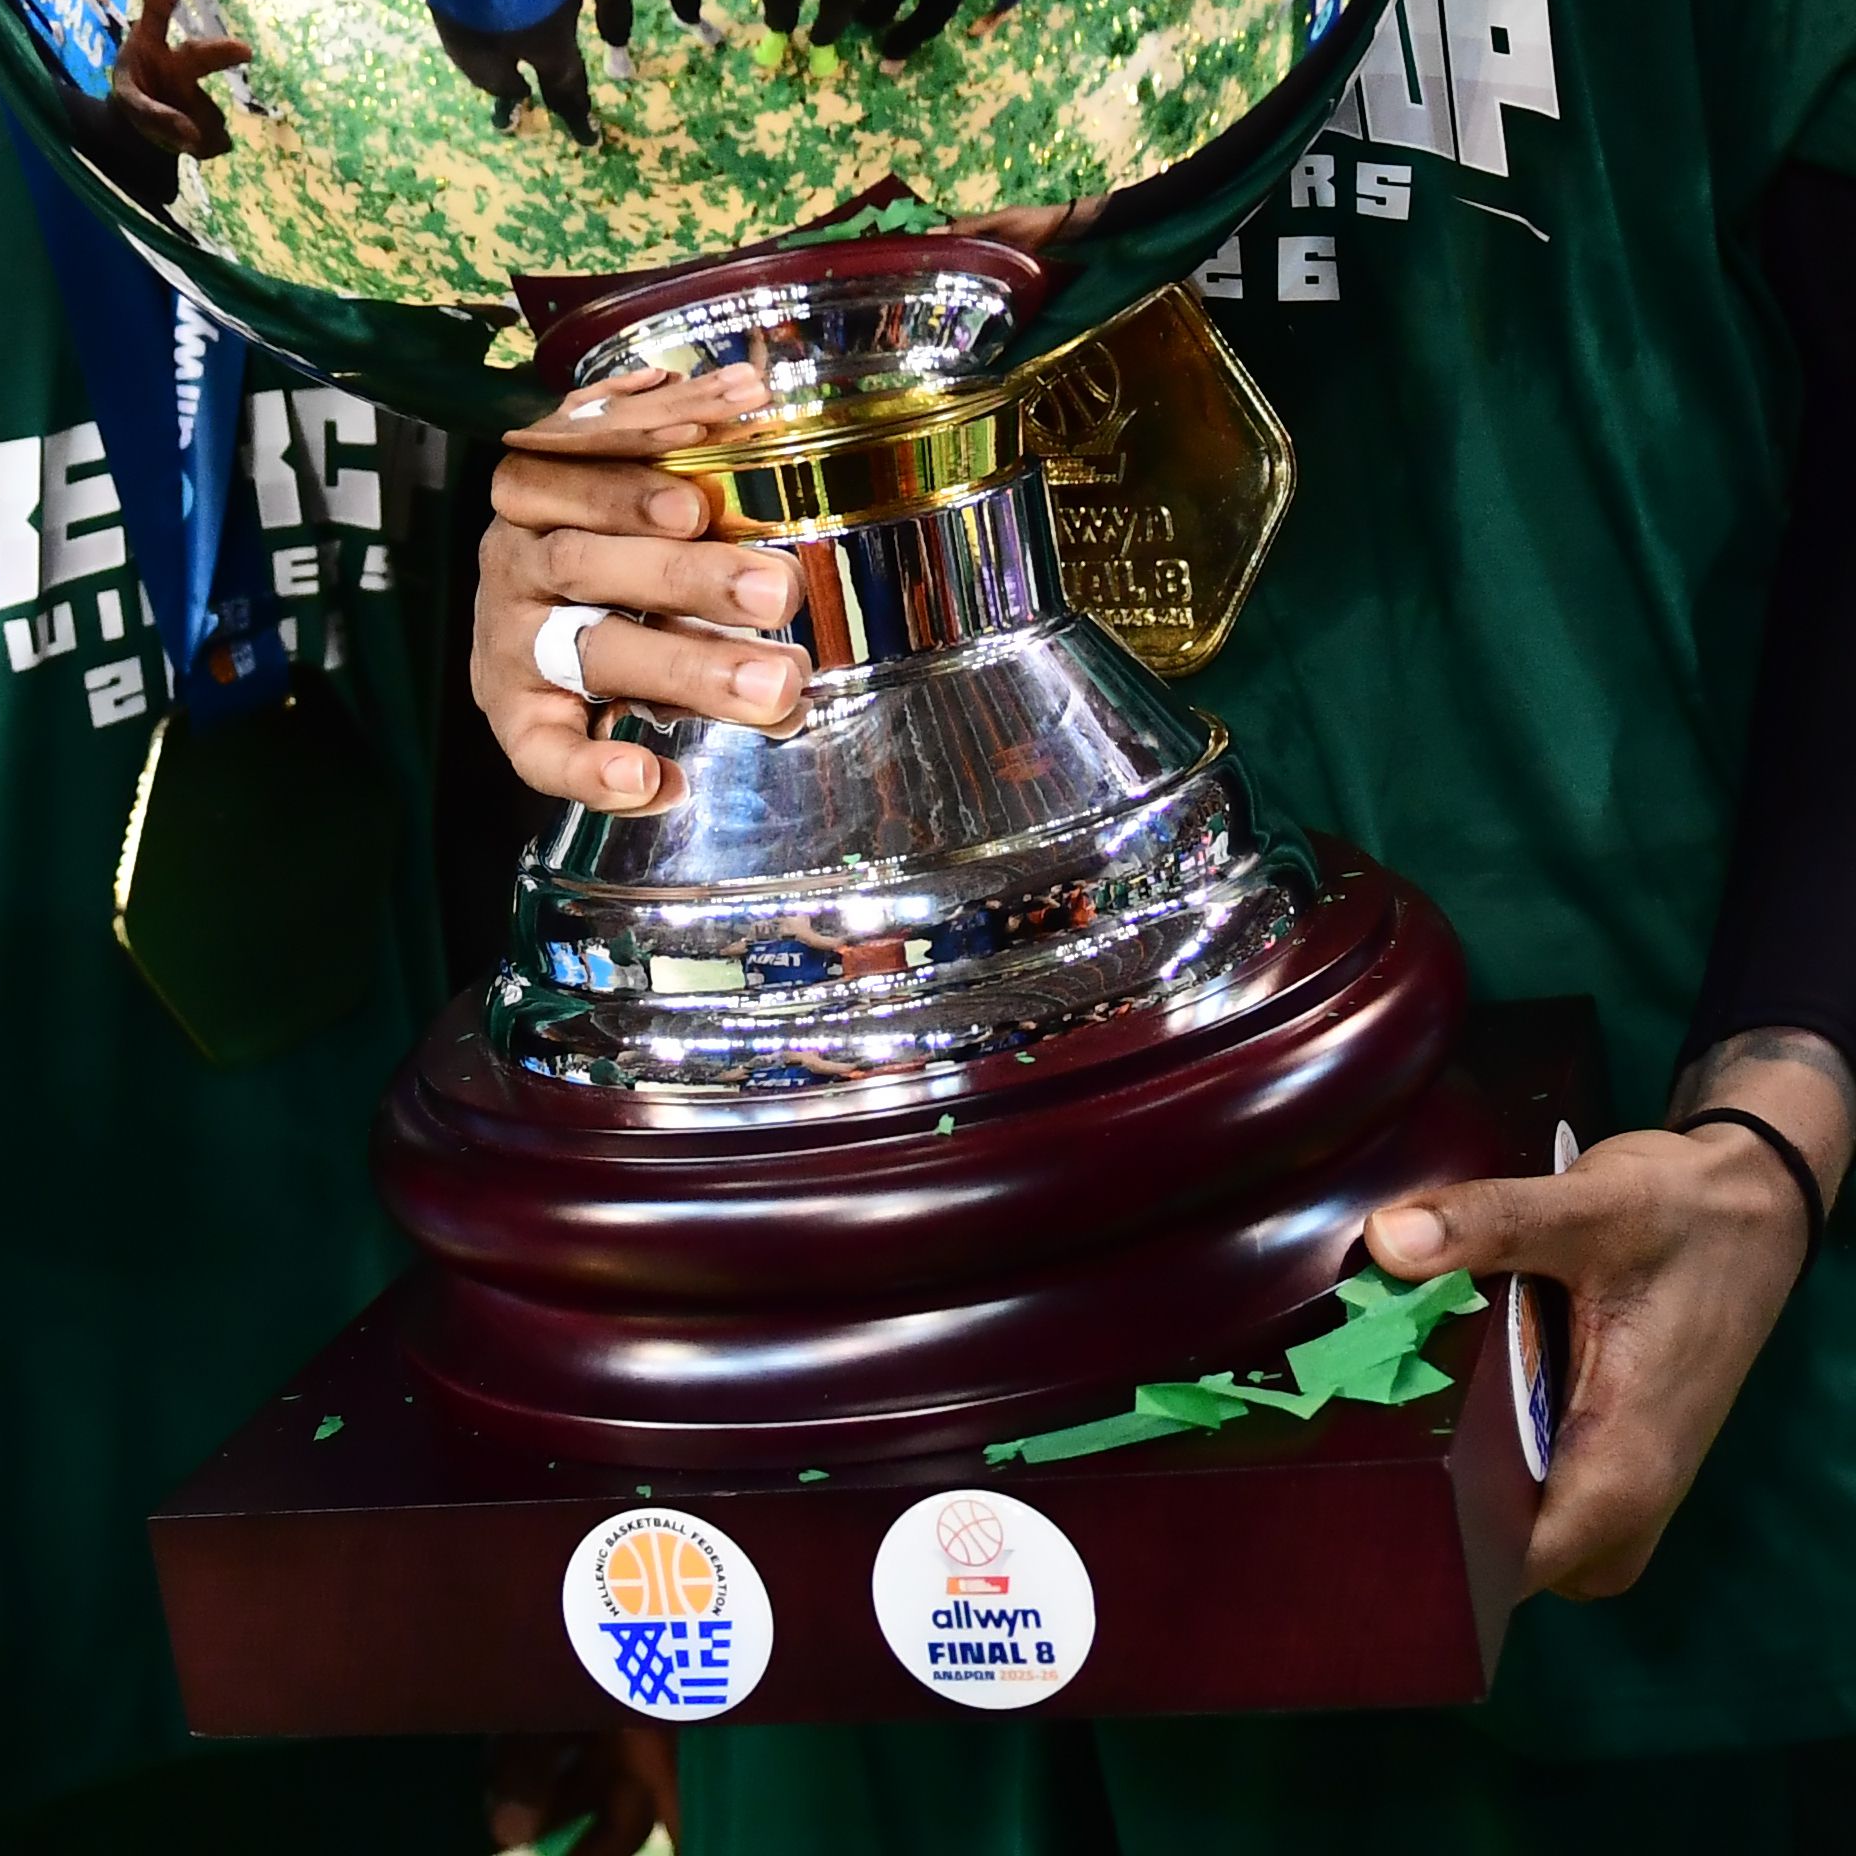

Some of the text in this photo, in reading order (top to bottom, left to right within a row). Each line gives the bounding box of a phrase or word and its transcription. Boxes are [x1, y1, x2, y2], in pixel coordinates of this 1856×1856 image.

[595, 1517, 728, 1618] HELLENIC BASKETBALL FEDERATION
[931, 1600, 1042, 1638] allwyn
[927, 1642, 1056, 1665] FINAL 8
